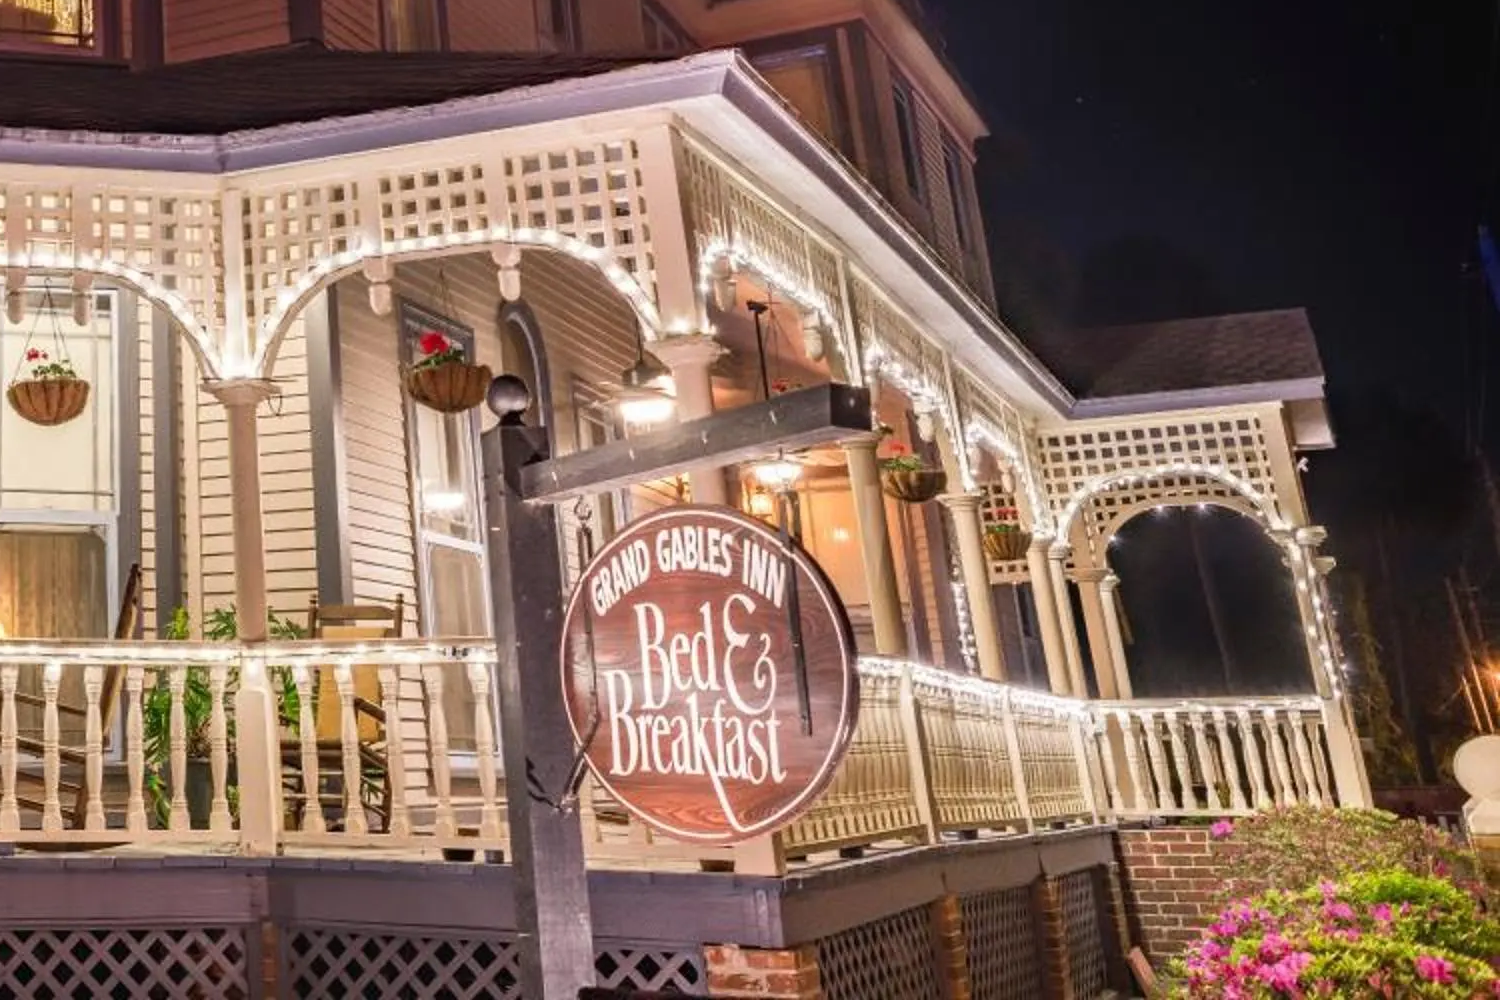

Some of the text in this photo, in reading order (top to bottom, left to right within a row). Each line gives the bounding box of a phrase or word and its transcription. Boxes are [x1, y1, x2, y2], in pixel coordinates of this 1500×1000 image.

[590, 525, 787, 616] GRAND GABLES INN
[633, 593, 778, 715] Bed &
[604, 668, 787, 785] Breakfast
